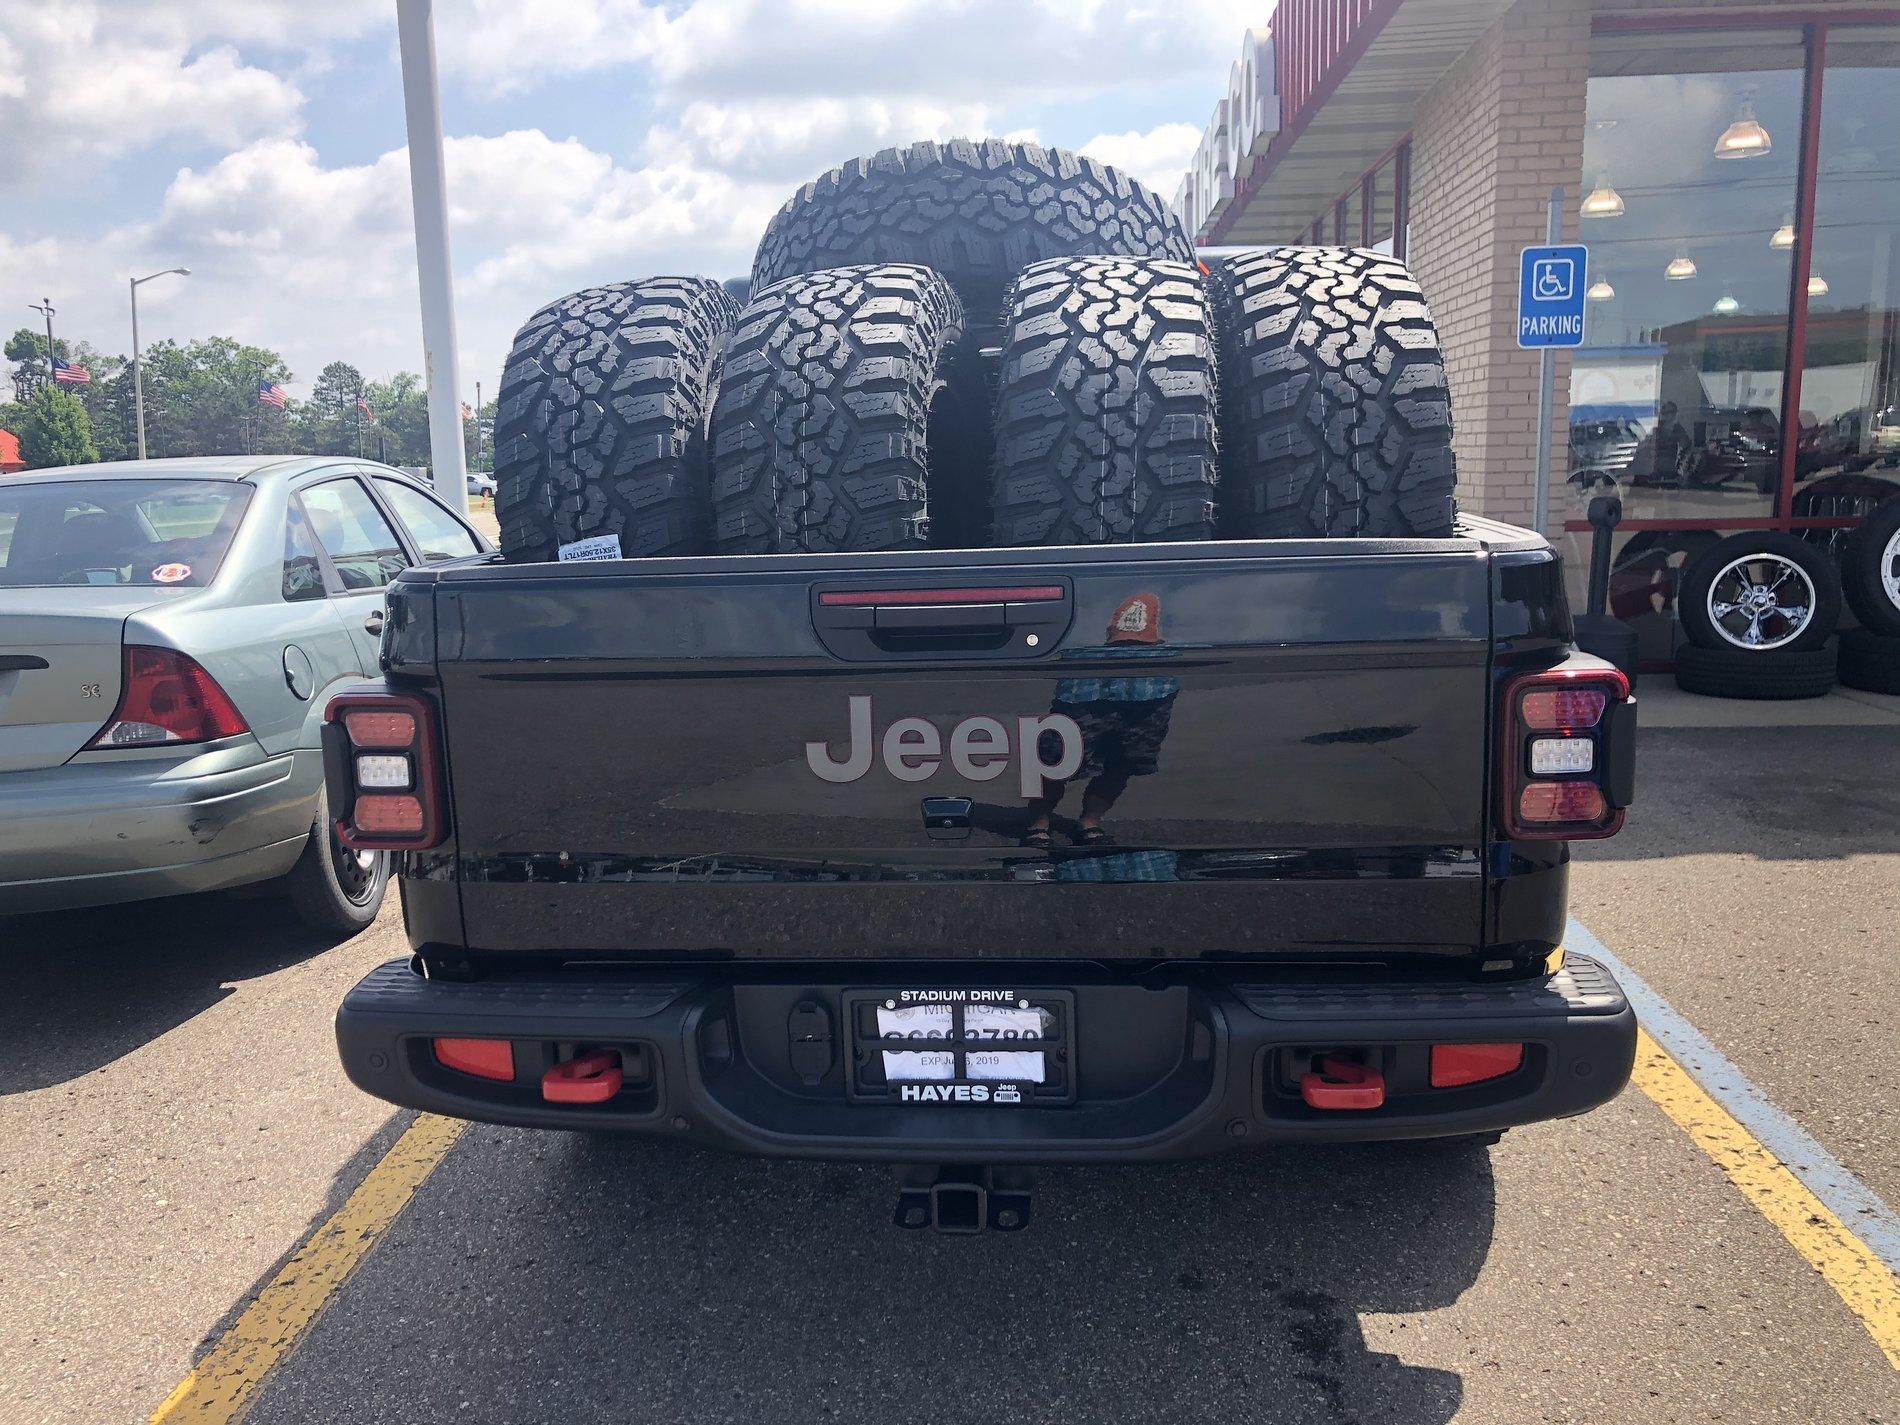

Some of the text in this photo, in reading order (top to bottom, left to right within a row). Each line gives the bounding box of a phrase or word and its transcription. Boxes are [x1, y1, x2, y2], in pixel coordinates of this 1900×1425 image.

[1521, 315, 1581, 336] PARKING
[81, 684, 101, 698] SE
[805, 694, 1084, 798] Jeep
[900, 990, 1014, 1001] STADIUM DRIVE
[976, 1056, 999, 1065] 2019
[901, 1084, 990, 1101] HAYES
[998, 1083, 1017, 1091] Jeep
